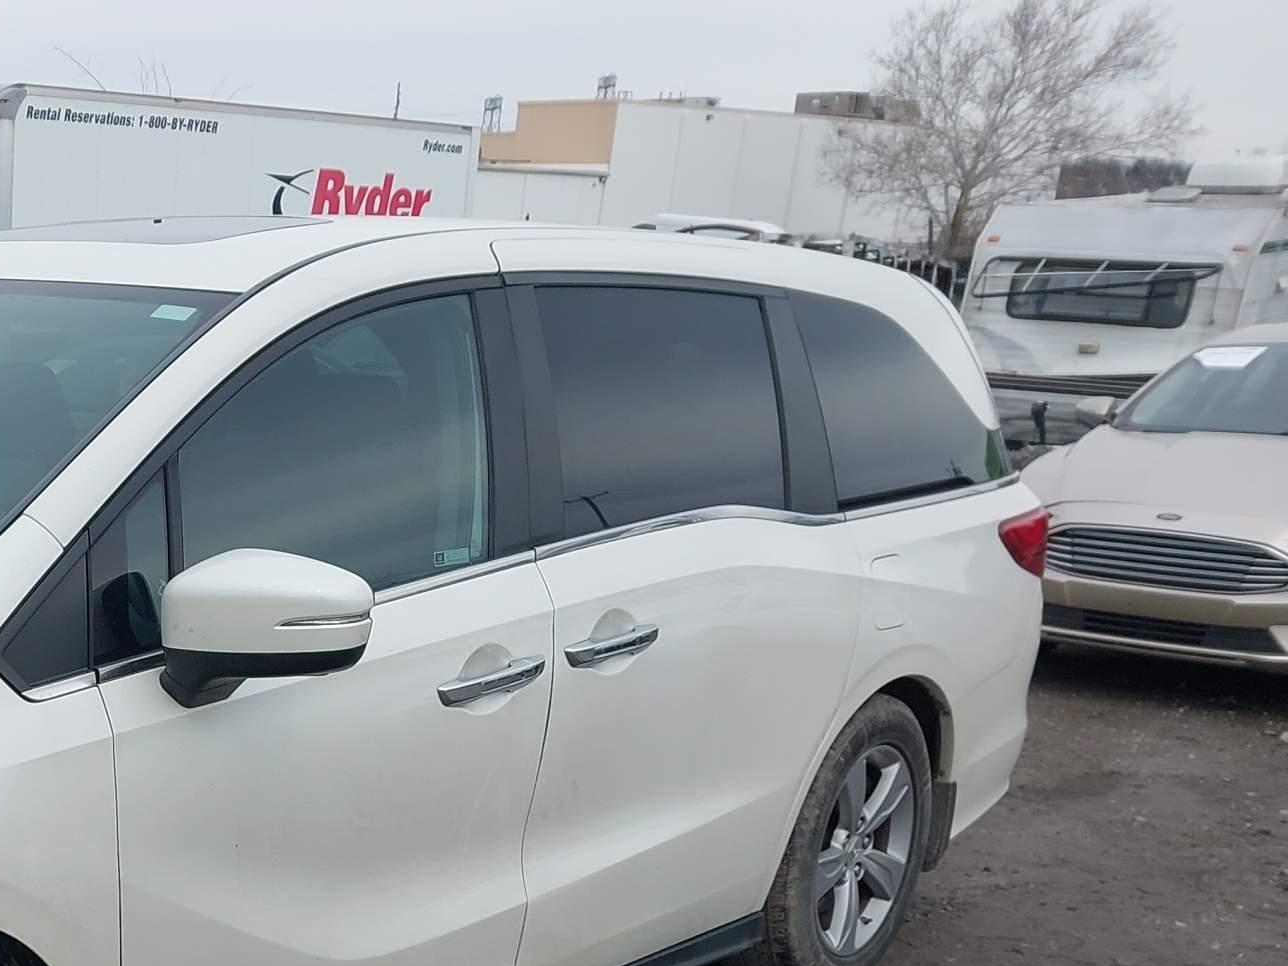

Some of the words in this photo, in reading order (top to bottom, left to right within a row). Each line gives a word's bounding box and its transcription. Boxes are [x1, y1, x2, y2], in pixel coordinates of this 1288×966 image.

[26, 105, 61, 121] Rental
[64, 108, 135, 128] Reservations:
[138, 114, 219, 134] 1-800-BY-RYDER
[423, 139, 462, 154] Ryder.com
